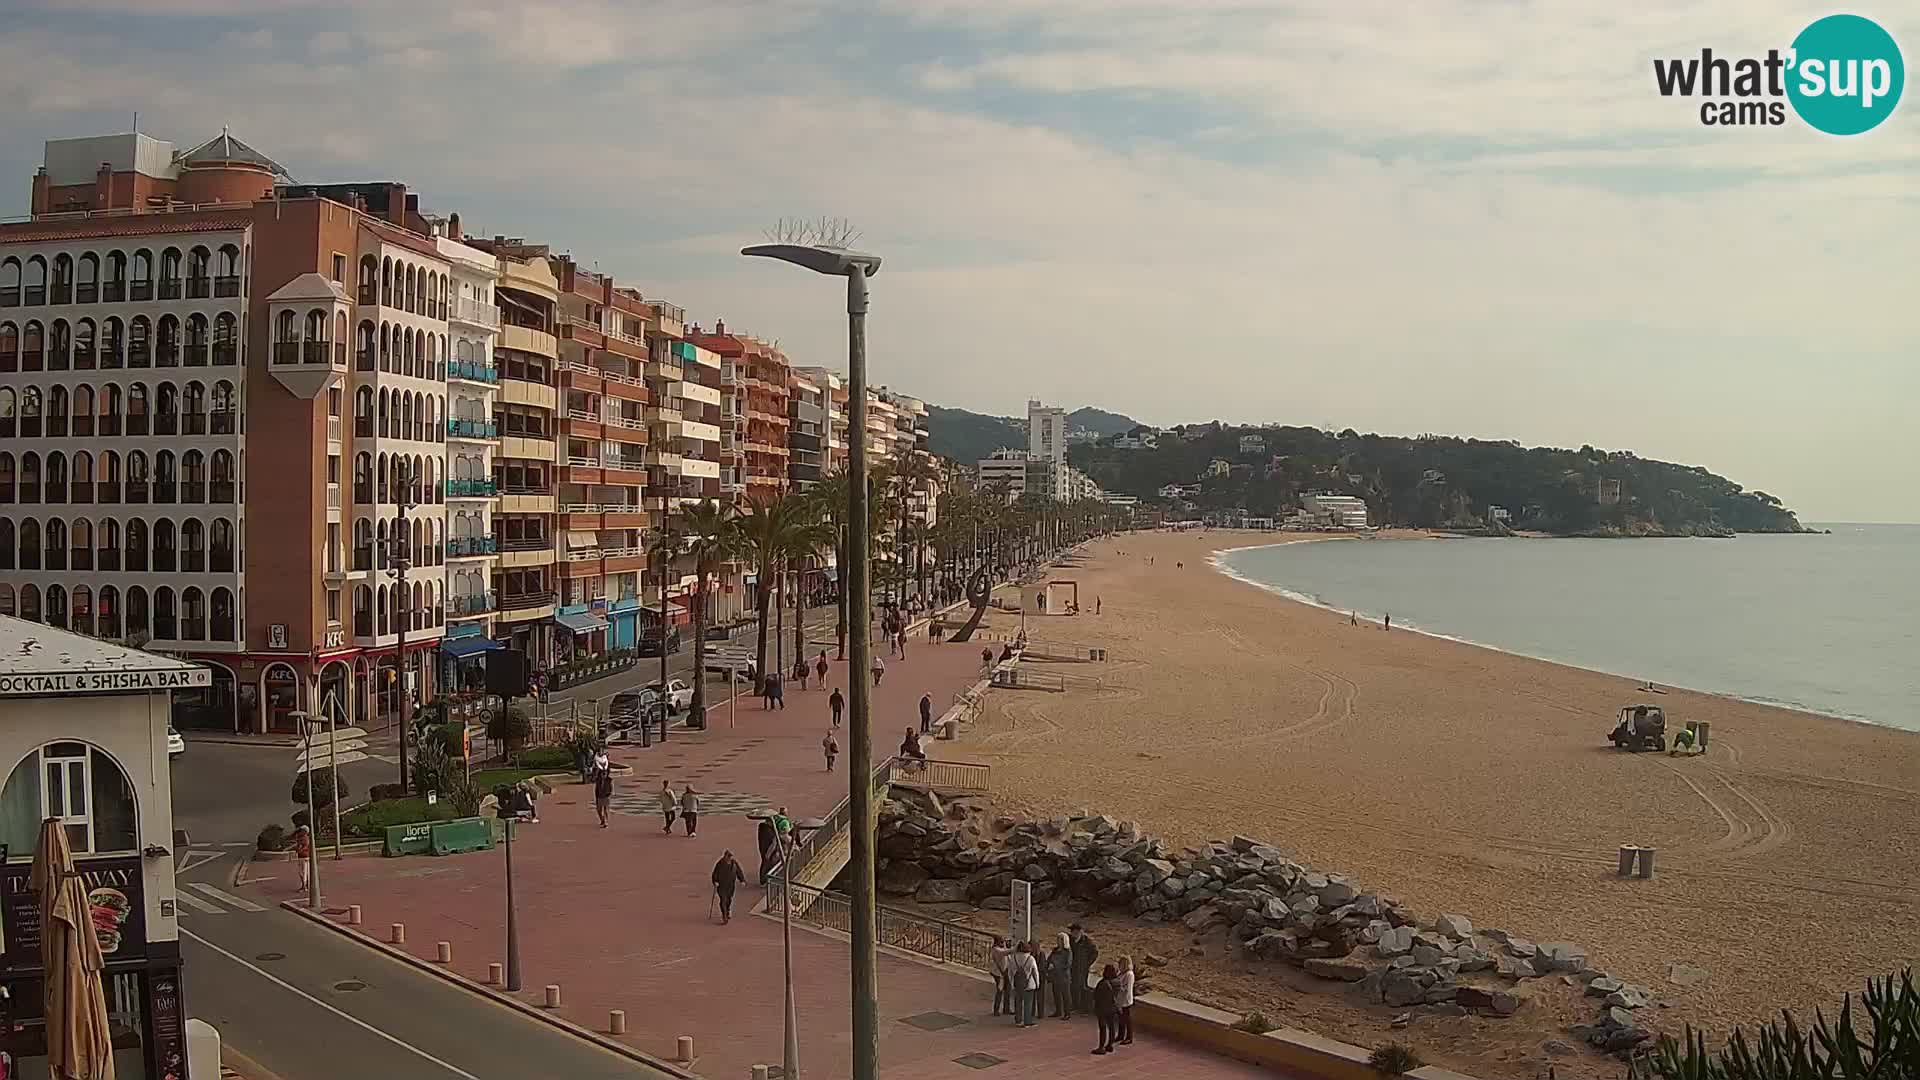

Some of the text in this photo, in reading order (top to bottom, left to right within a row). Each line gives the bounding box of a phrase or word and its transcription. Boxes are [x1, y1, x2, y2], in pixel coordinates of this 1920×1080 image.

[326, 630, 345, 648] KFC
[76, 675, 87, 689] &
[91, 673, 153, 688] SHISHA
[158, 671, 190, 686] BAR
[271, 670, 293, 680] KFC
